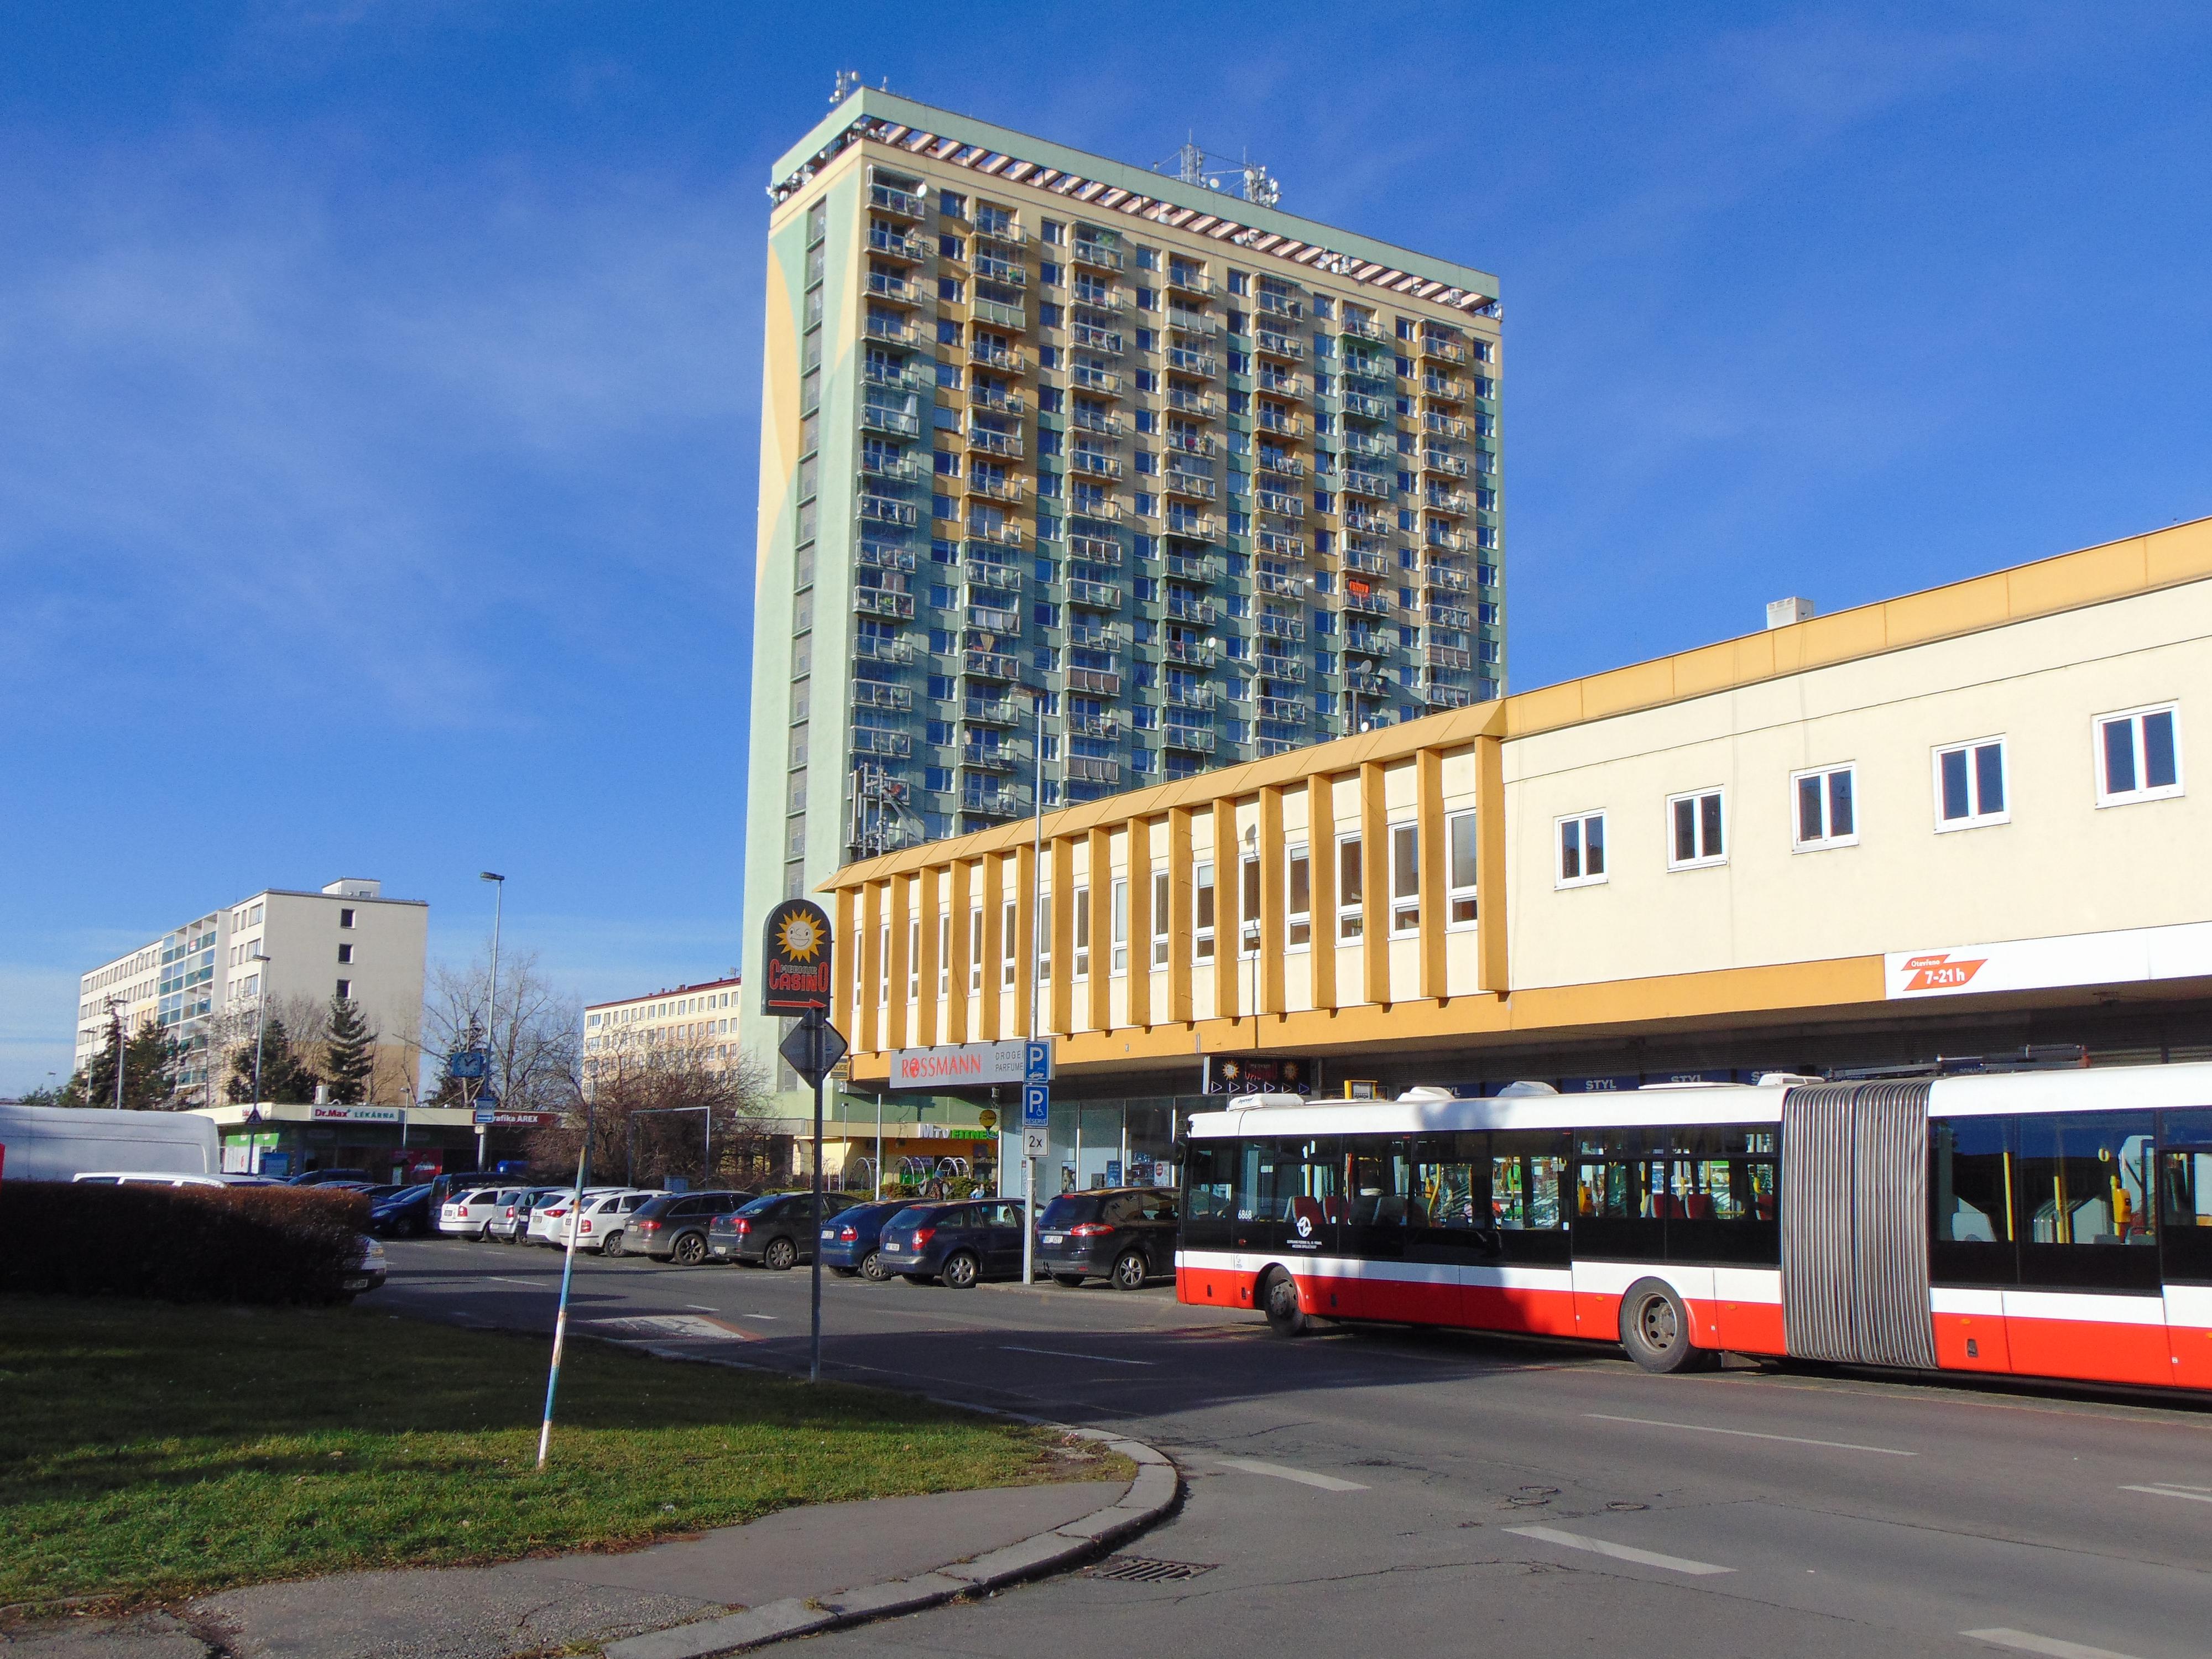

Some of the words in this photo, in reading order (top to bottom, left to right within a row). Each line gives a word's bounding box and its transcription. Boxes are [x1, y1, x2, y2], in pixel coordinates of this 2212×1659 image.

[780, 964, 818, 974] MERKUR
[1911, 959, 1940, 967] Otevřeno
[769, 958, 828, 993] CASINO
[1924, 969, 1953, 984] 7-21
[1956, 968, 1965, 982] h
[995, 1051, 1024, 1060] DROGE
[1029, 1047, 1044, 1070] P
[901, 1053, 982, 1078] ROSSMANN
[995, 1062, 1024, 1072] PARFUME
[1585, 1079, 1616, 1091] STYL
[1029, 1090, 1044, 1113] P
[315, 1108, 348, 1118] Dr.Max
[354, 1110, 394, 1119] LÉKÁRNA
[919, 1124, 951, 1139] MTV
[951, 1129, 999, 1139] FITNE
[1029, 1135, 1042, 1147] 2x
[1238, 1209, 1252, 1219] 6868
